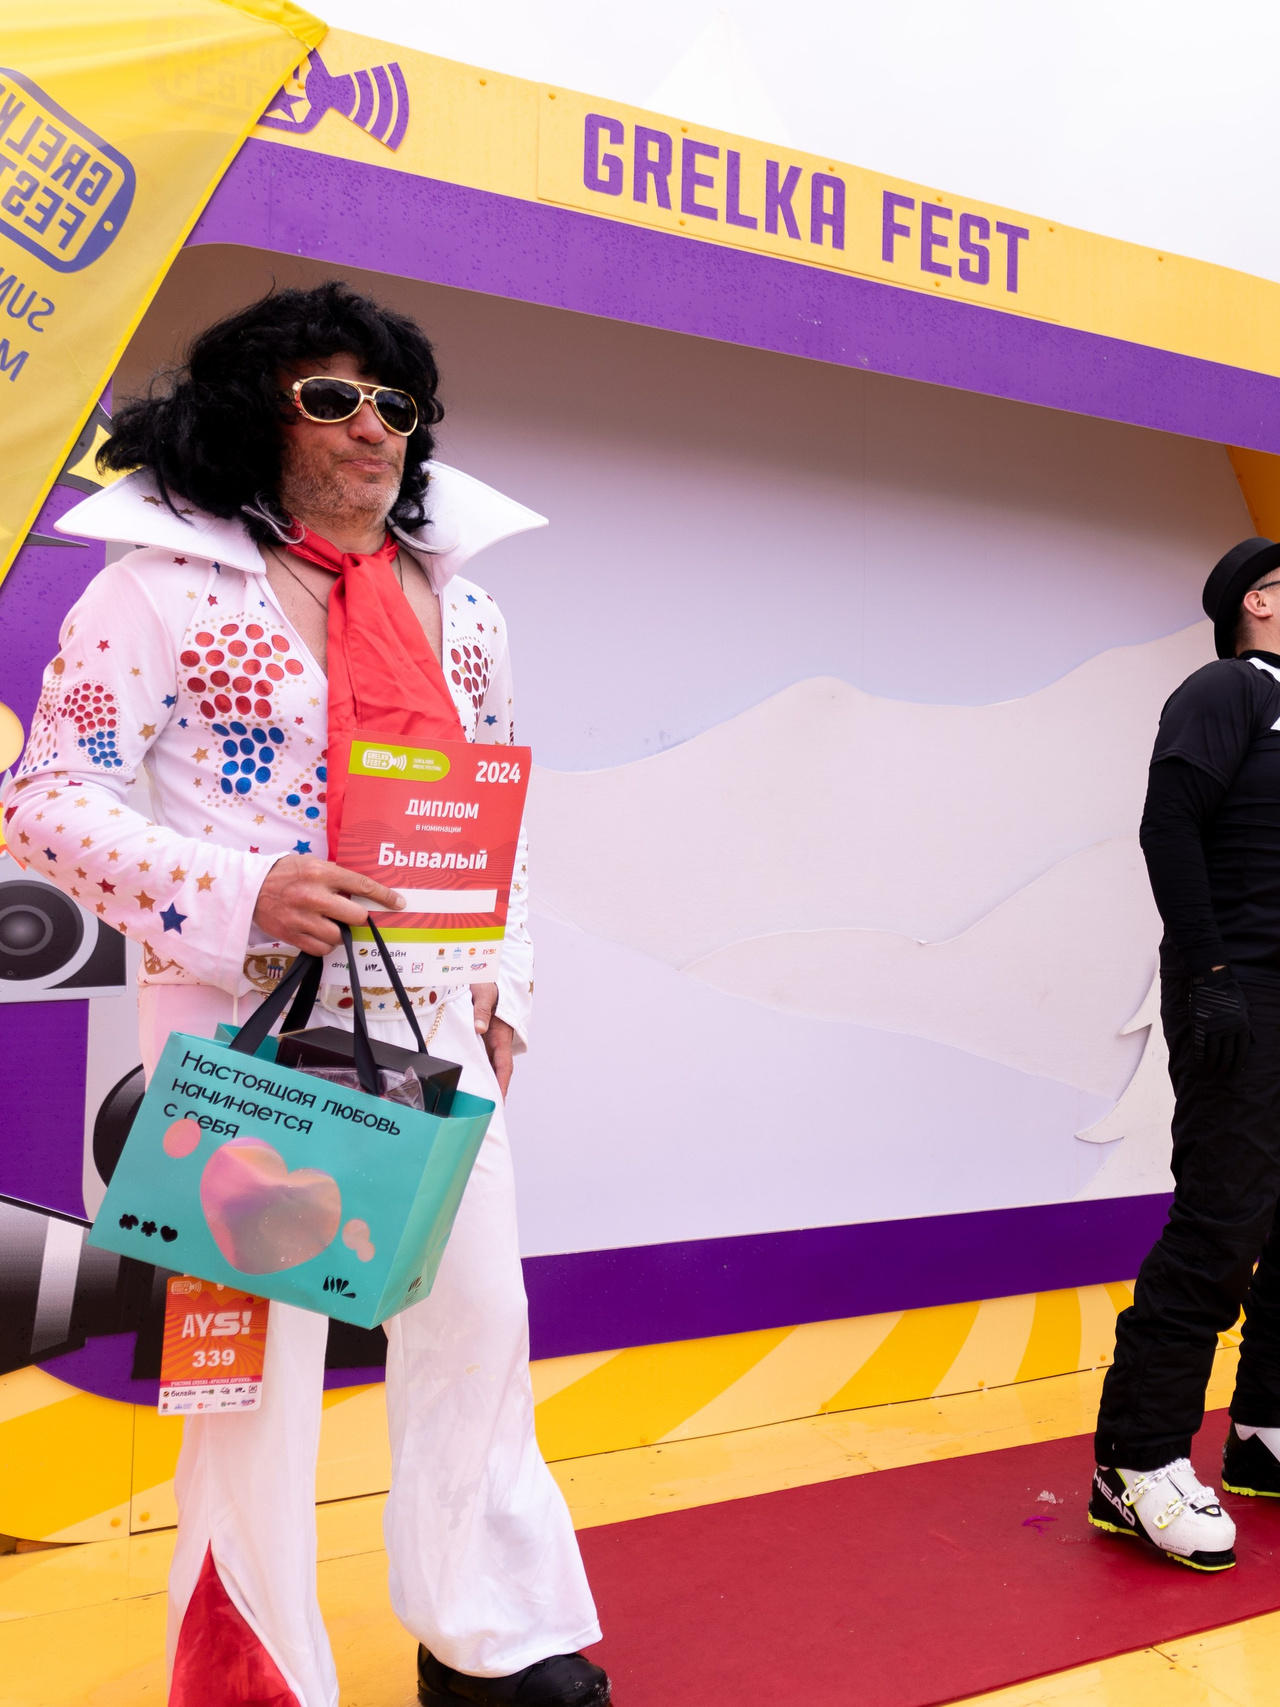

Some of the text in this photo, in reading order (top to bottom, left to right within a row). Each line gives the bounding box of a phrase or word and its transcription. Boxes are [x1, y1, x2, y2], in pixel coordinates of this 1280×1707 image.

[583, 112, 1030, 294] GRELKA FEST
[475, 761, 521, 784] 2024
[404, 798, 479, 820] ДИПЛОМ
[422, 824, 462, 834] номинации
[378, 842, 488, 870] Бывалый
[171, 1078, 314, 1135] начинается
[181, 1051, 401, 1136] Настоящая любовь
[181, 1311, 252, 1338] AYS!
[192, 1349, 235, 1368] 339
[1094, 1468, 1135, 1527] HEAD
